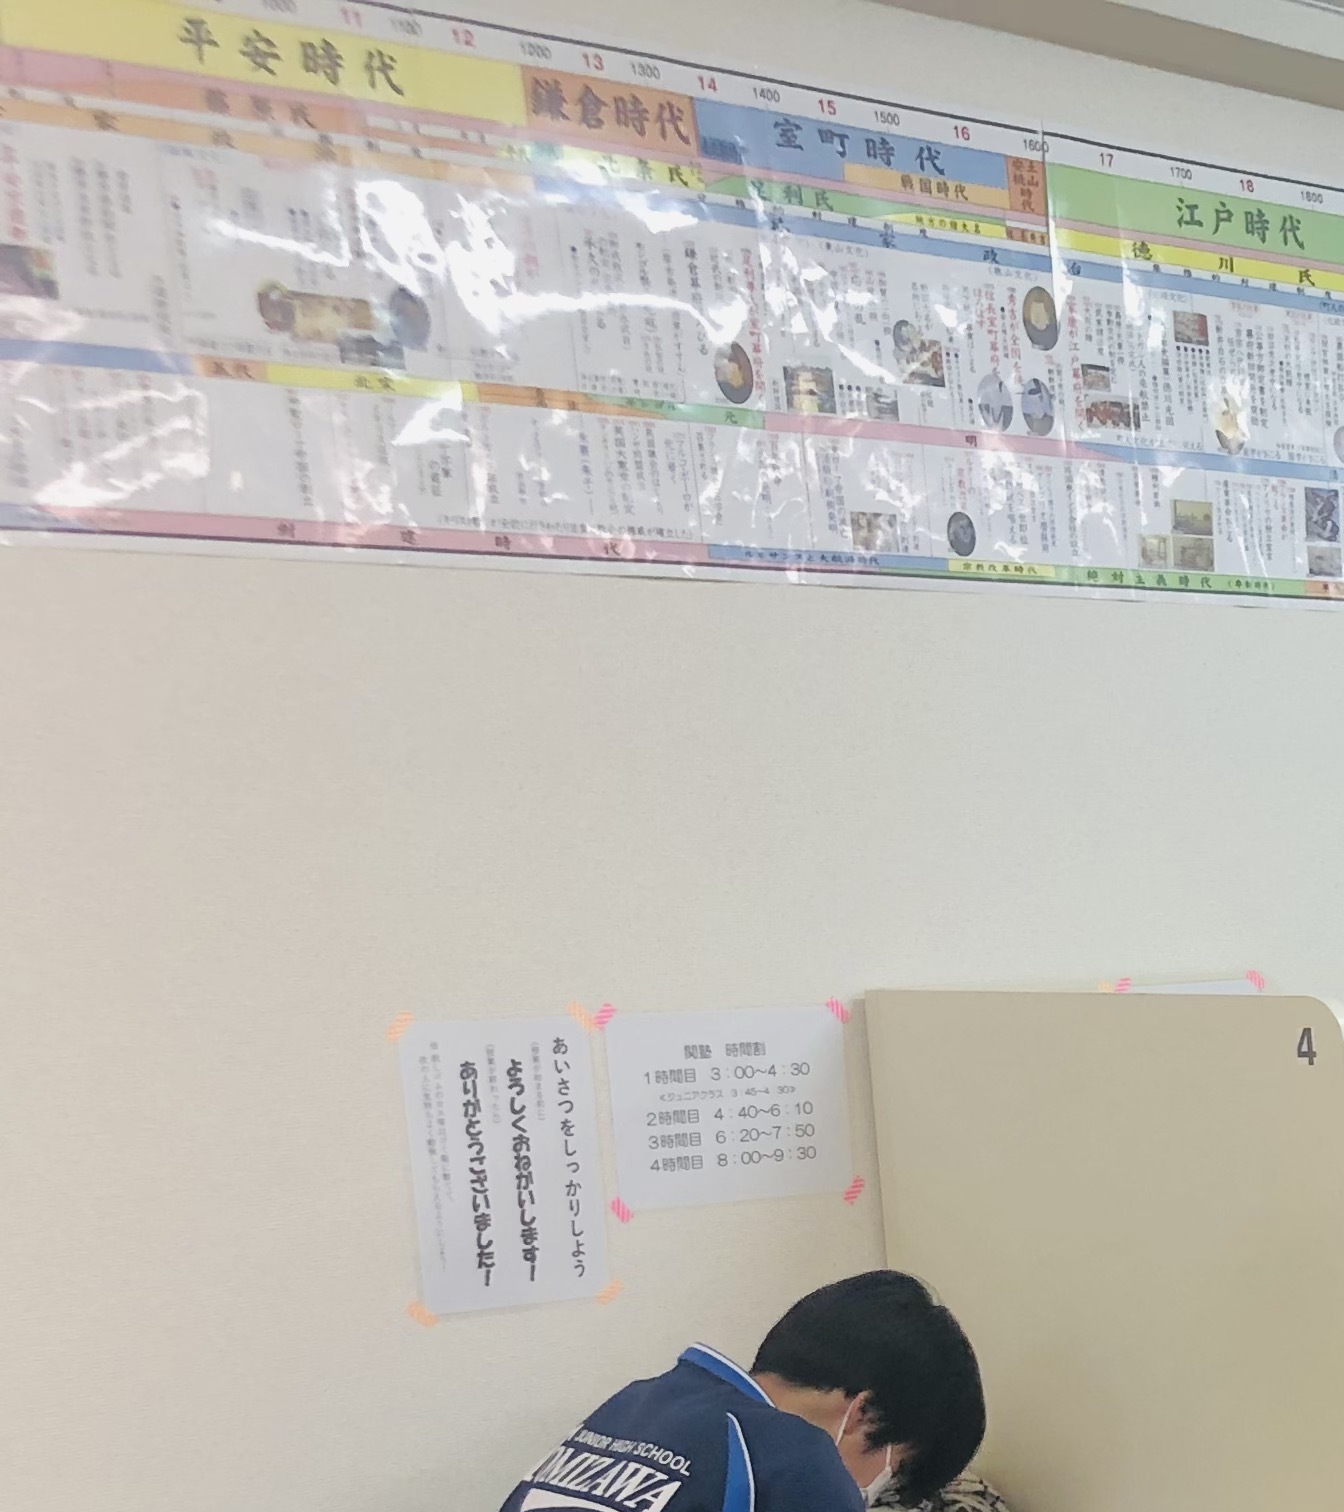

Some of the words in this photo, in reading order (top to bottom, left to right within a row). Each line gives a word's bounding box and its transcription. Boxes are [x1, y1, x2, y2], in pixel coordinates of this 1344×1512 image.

[178, 16, 405, 98] 平安時代
[582, 51, 605, 72] 13
[630, 61, 661, 81] 1300
[698, 75, 718, 94] 14
[752, 86, 781, 104] 1400
[529, 75, 692, 146] 鎌倉時代
[818, 98, 837, 117] 15
[873, 109, 901, 127] 1500
[953, 124, 971, 142] 16
[772, 117, 947, 177] 室町時代
[1022, 137, 1050, 154] 1600
[1099, 152, 1114, 168] 17
[1169, 166, 1193, 181] 1700
[1239, 178, 1255, 194] 18
[1175, 197, 1306, 252] 江戸時代
[1297, 1027, 1317, 1066] 4
[644, 1068, 697, 1085] 1時間目
[646, 1108, 700, 1127] 2時間目
[648, 1132, 702, 1150] 3時間目
[552, 1036, 586, 1278] あいさつをしっかりしよう
[650, 1155, 704, 1172] 4時間目
[575, 1429, 613, 1449] JUNIOR
[609, 1438, 636, 1454] HIGH
[633, 1441, 692, 1477] SCHOOL
